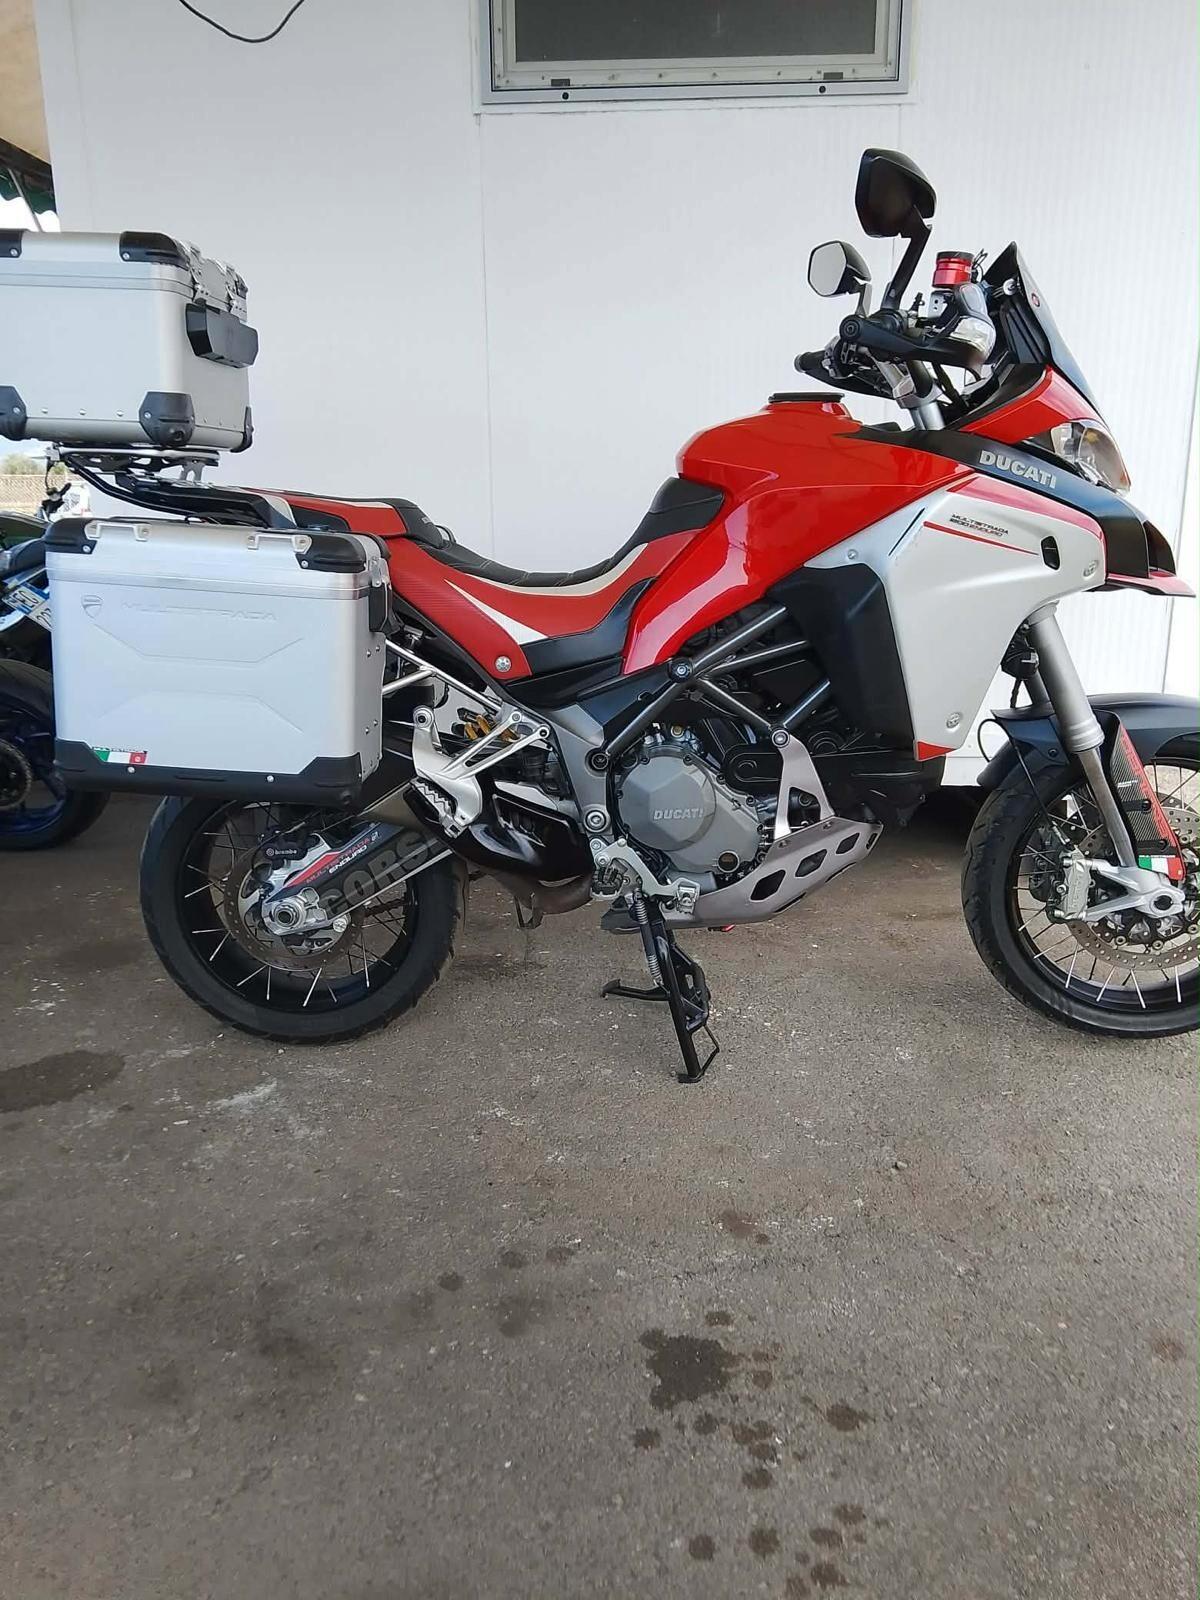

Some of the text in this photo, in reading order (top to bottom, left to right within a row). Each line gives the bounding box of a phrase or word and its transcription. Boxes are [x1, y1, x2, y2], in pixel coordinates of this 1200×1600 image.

[980, 450, 1057, 489] DUCATI
[951, 513, 1009, 535] MULTISTRADA
[653, 807, 704, 821] DUCATI
[328, 844, 367, 874] ENDURO
